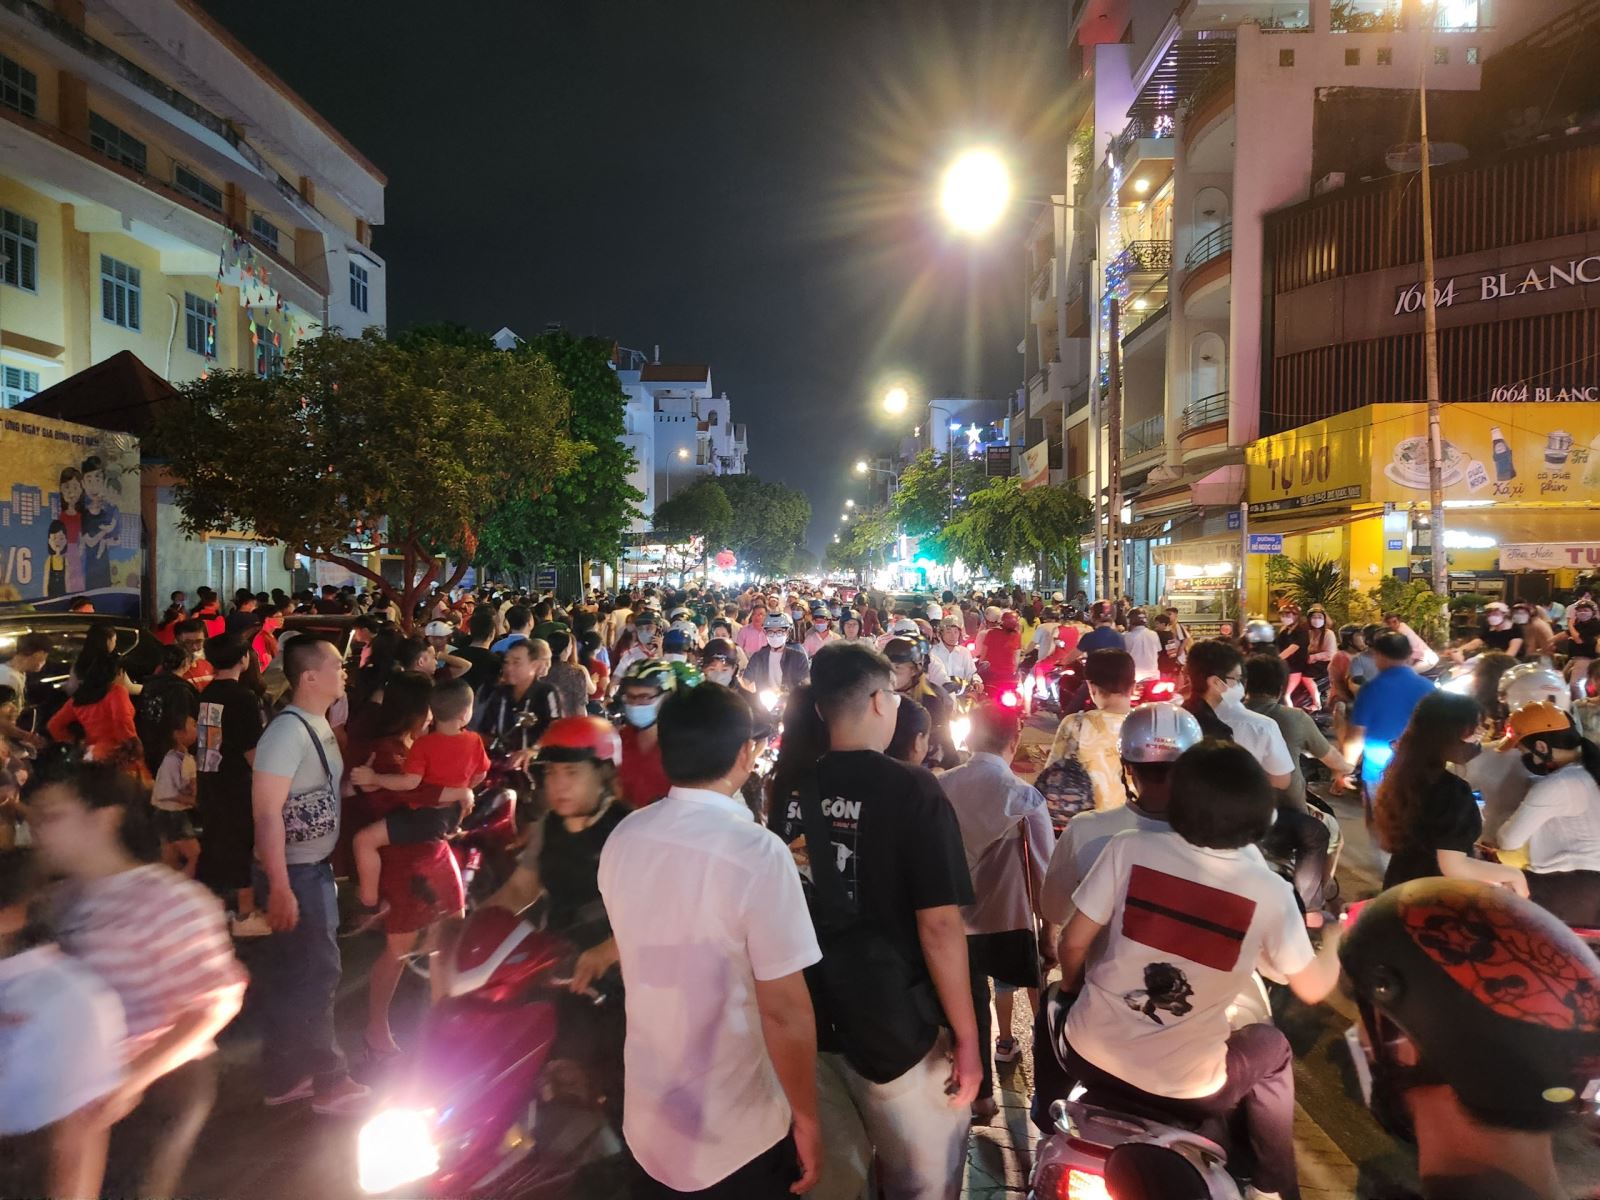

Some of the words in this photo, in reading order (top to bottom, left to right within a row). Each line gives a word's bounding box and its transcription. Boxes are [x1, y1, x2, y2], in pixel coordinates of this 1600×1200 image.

[1480, 256, 1600, 300] BLANC
[1490, 384, 1529, 402] 1664
[1535, 386, 1599, 402] BLANC
[1301, 445, 1330, 486] DO
[0, 546, 32, 584] /6
[821, 796, 862, 819] GÒN
